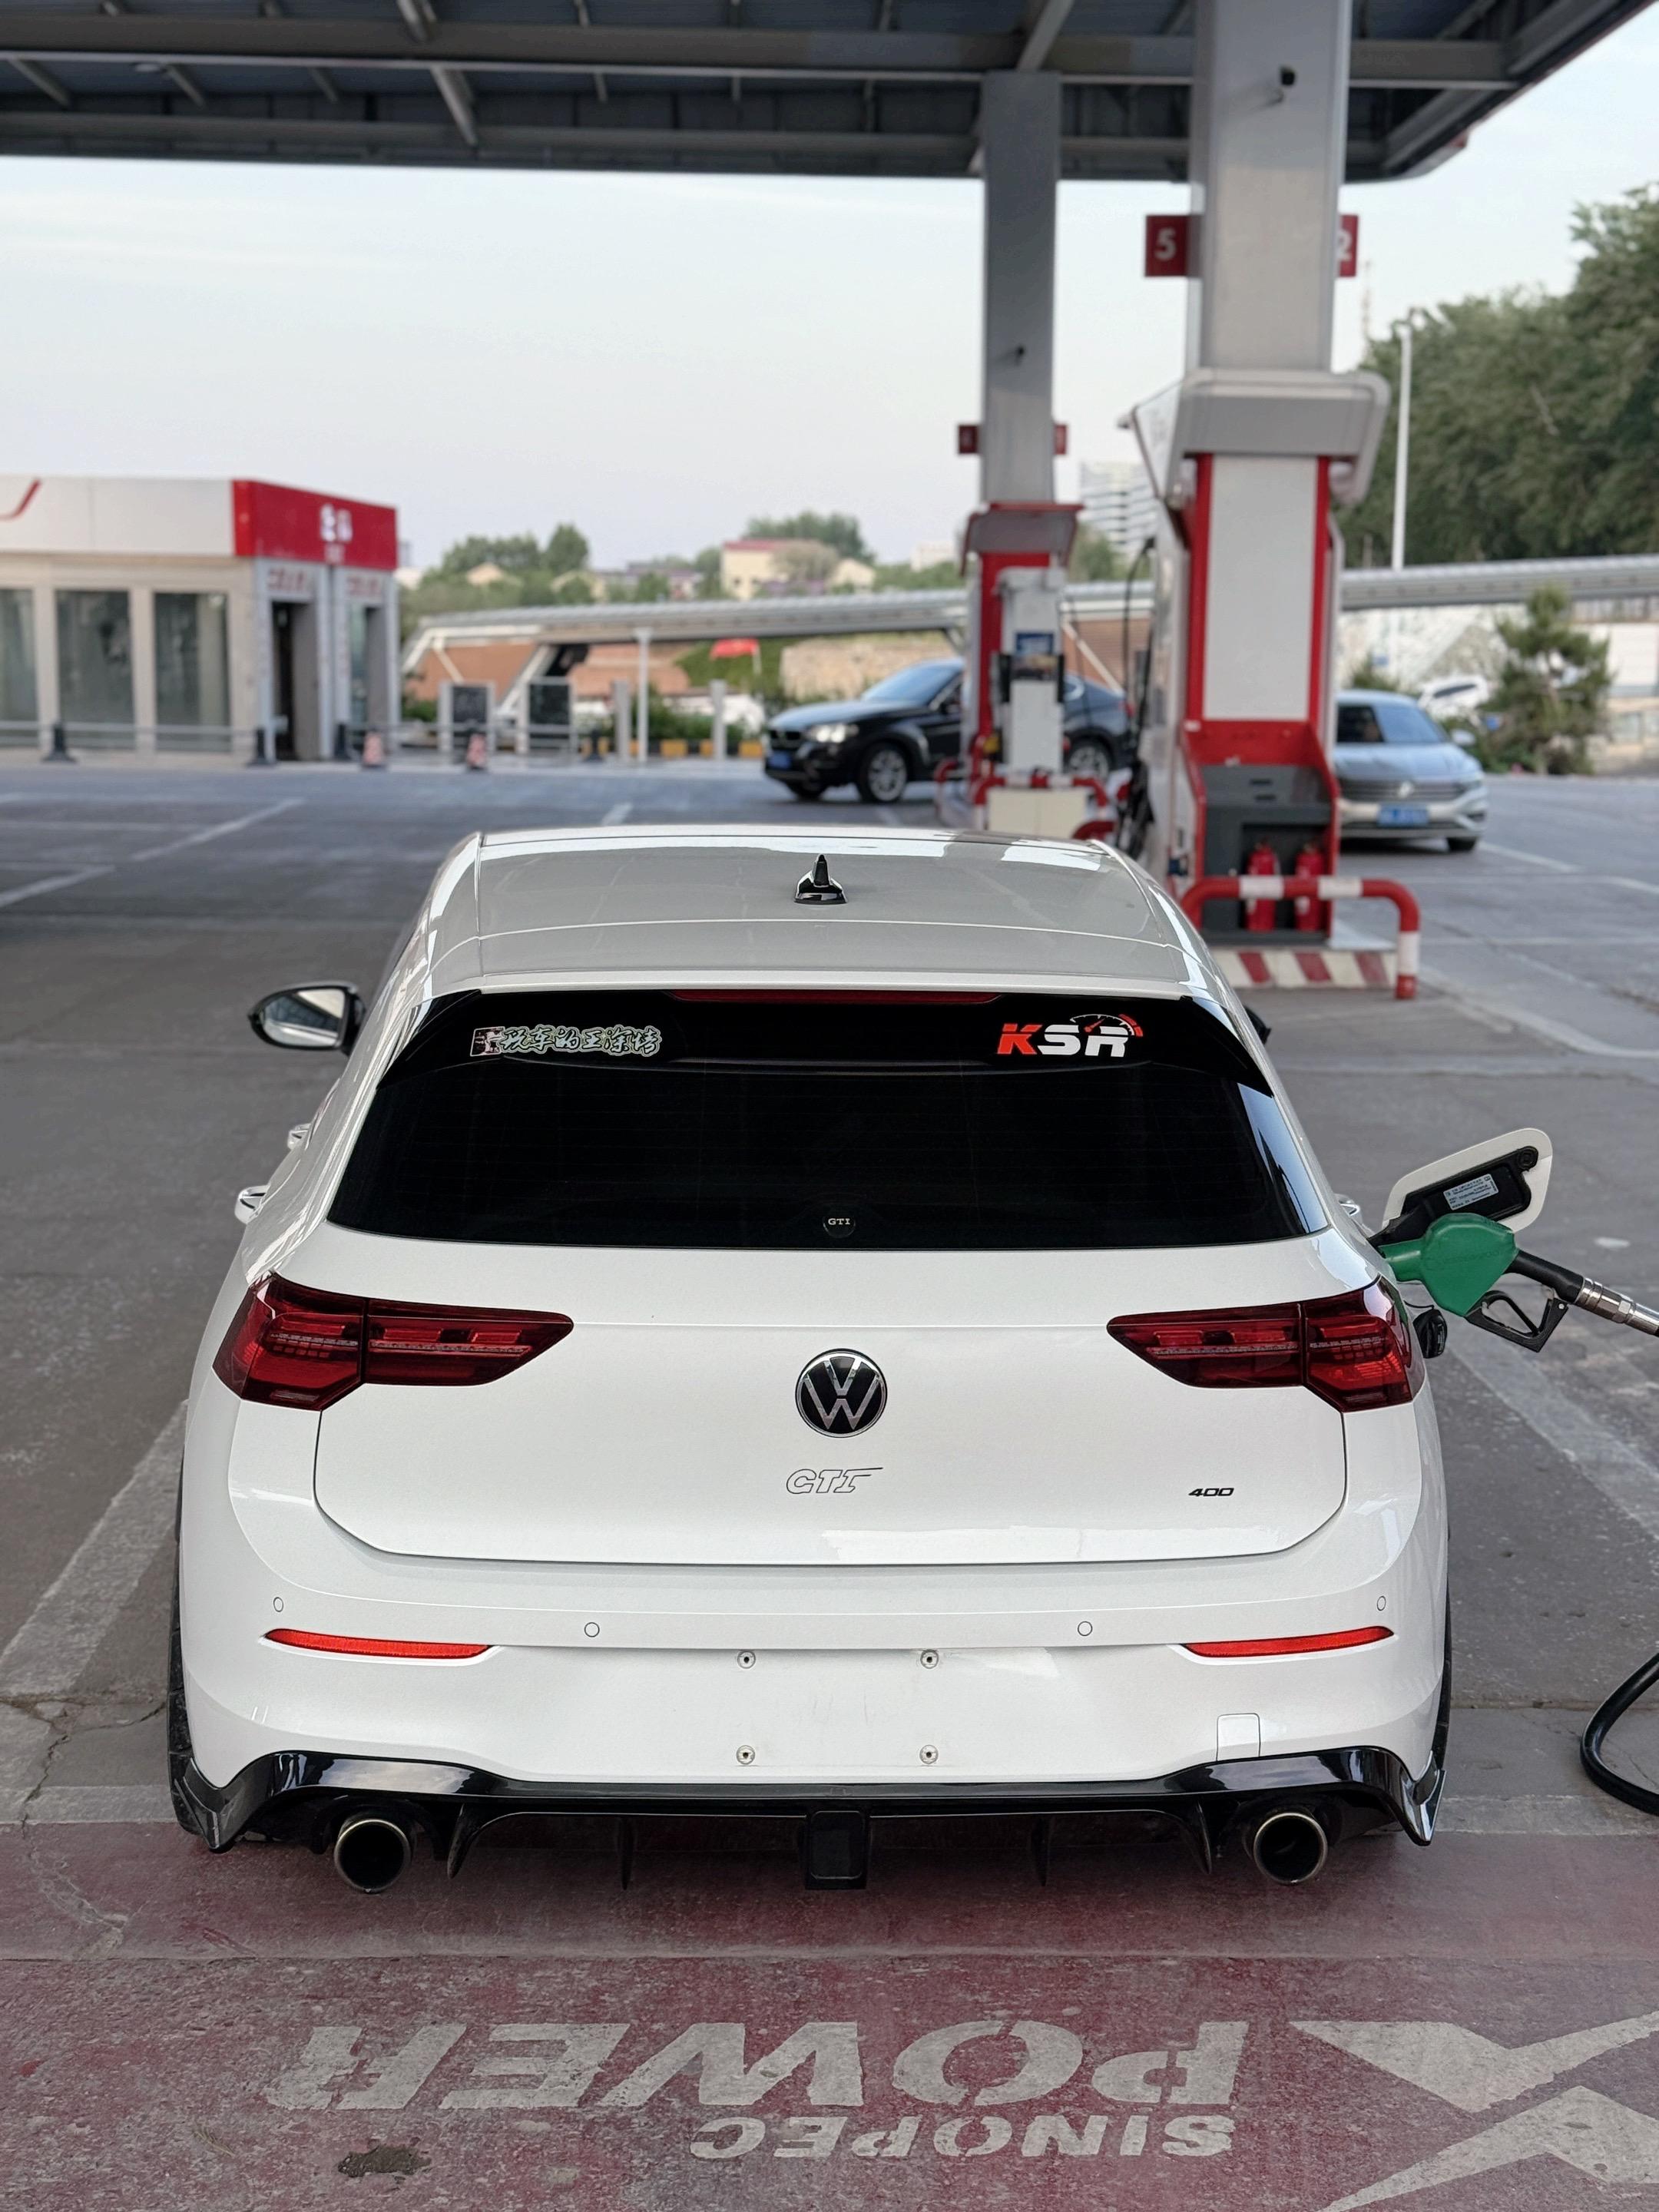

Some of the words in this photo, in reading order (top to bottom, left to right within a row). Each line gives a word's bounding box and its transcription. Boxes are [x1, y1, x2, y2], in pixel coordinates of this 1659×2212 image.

[1154, 227, 1177, 261] 5
[827, 1217, 851, 1227] GTI
[1188, 1487, 1235, 1497] 400
[261, 2020, 1249, 2110] POWER
[690, 2114, 1234, 2161] SINOPEC
